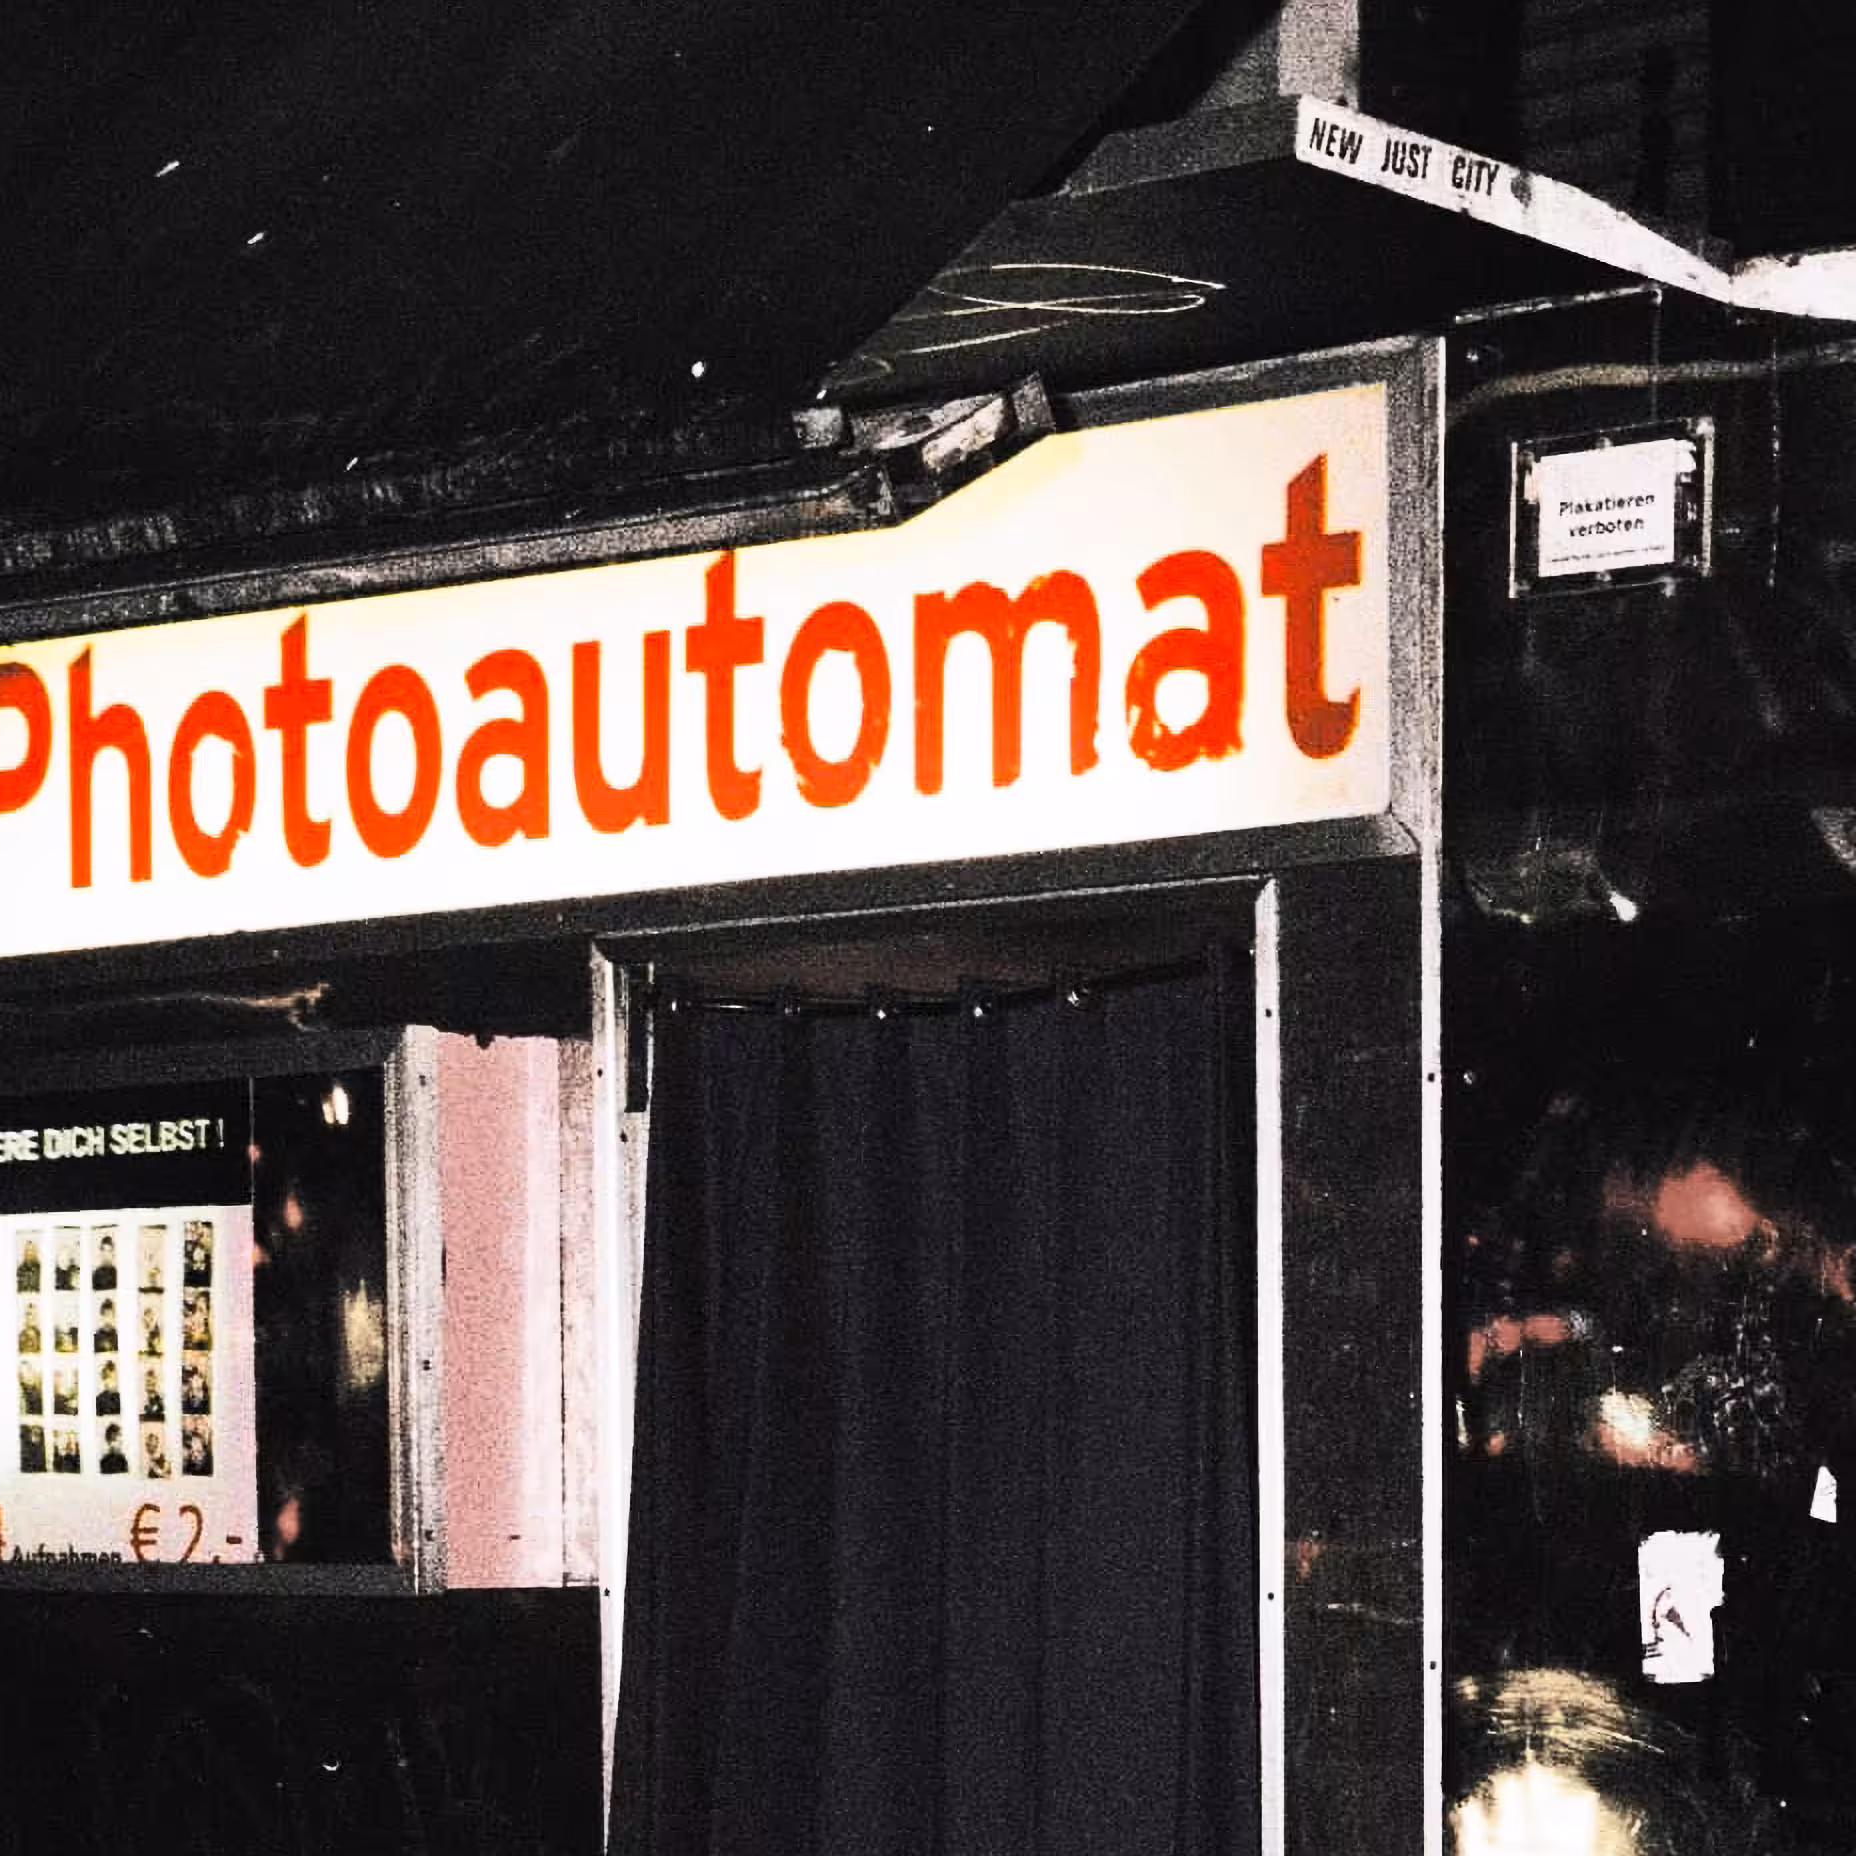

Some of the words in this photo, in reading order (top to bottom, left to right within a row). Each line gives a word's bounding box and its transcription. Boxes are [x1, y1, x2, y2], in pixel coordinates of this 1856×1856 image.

[1309, 116, 1363, 165] NEW
[1380, 138, 1433, 180] JUST
[1452, 153, 1500, 197] CITY
[1559, 494, 1656, 516] Plakatieren
[1569, 518, 1645, 538] verboten
[43, 1125, 105, 1160] DICH
[109, 1119, 210, 1155] SELBST
